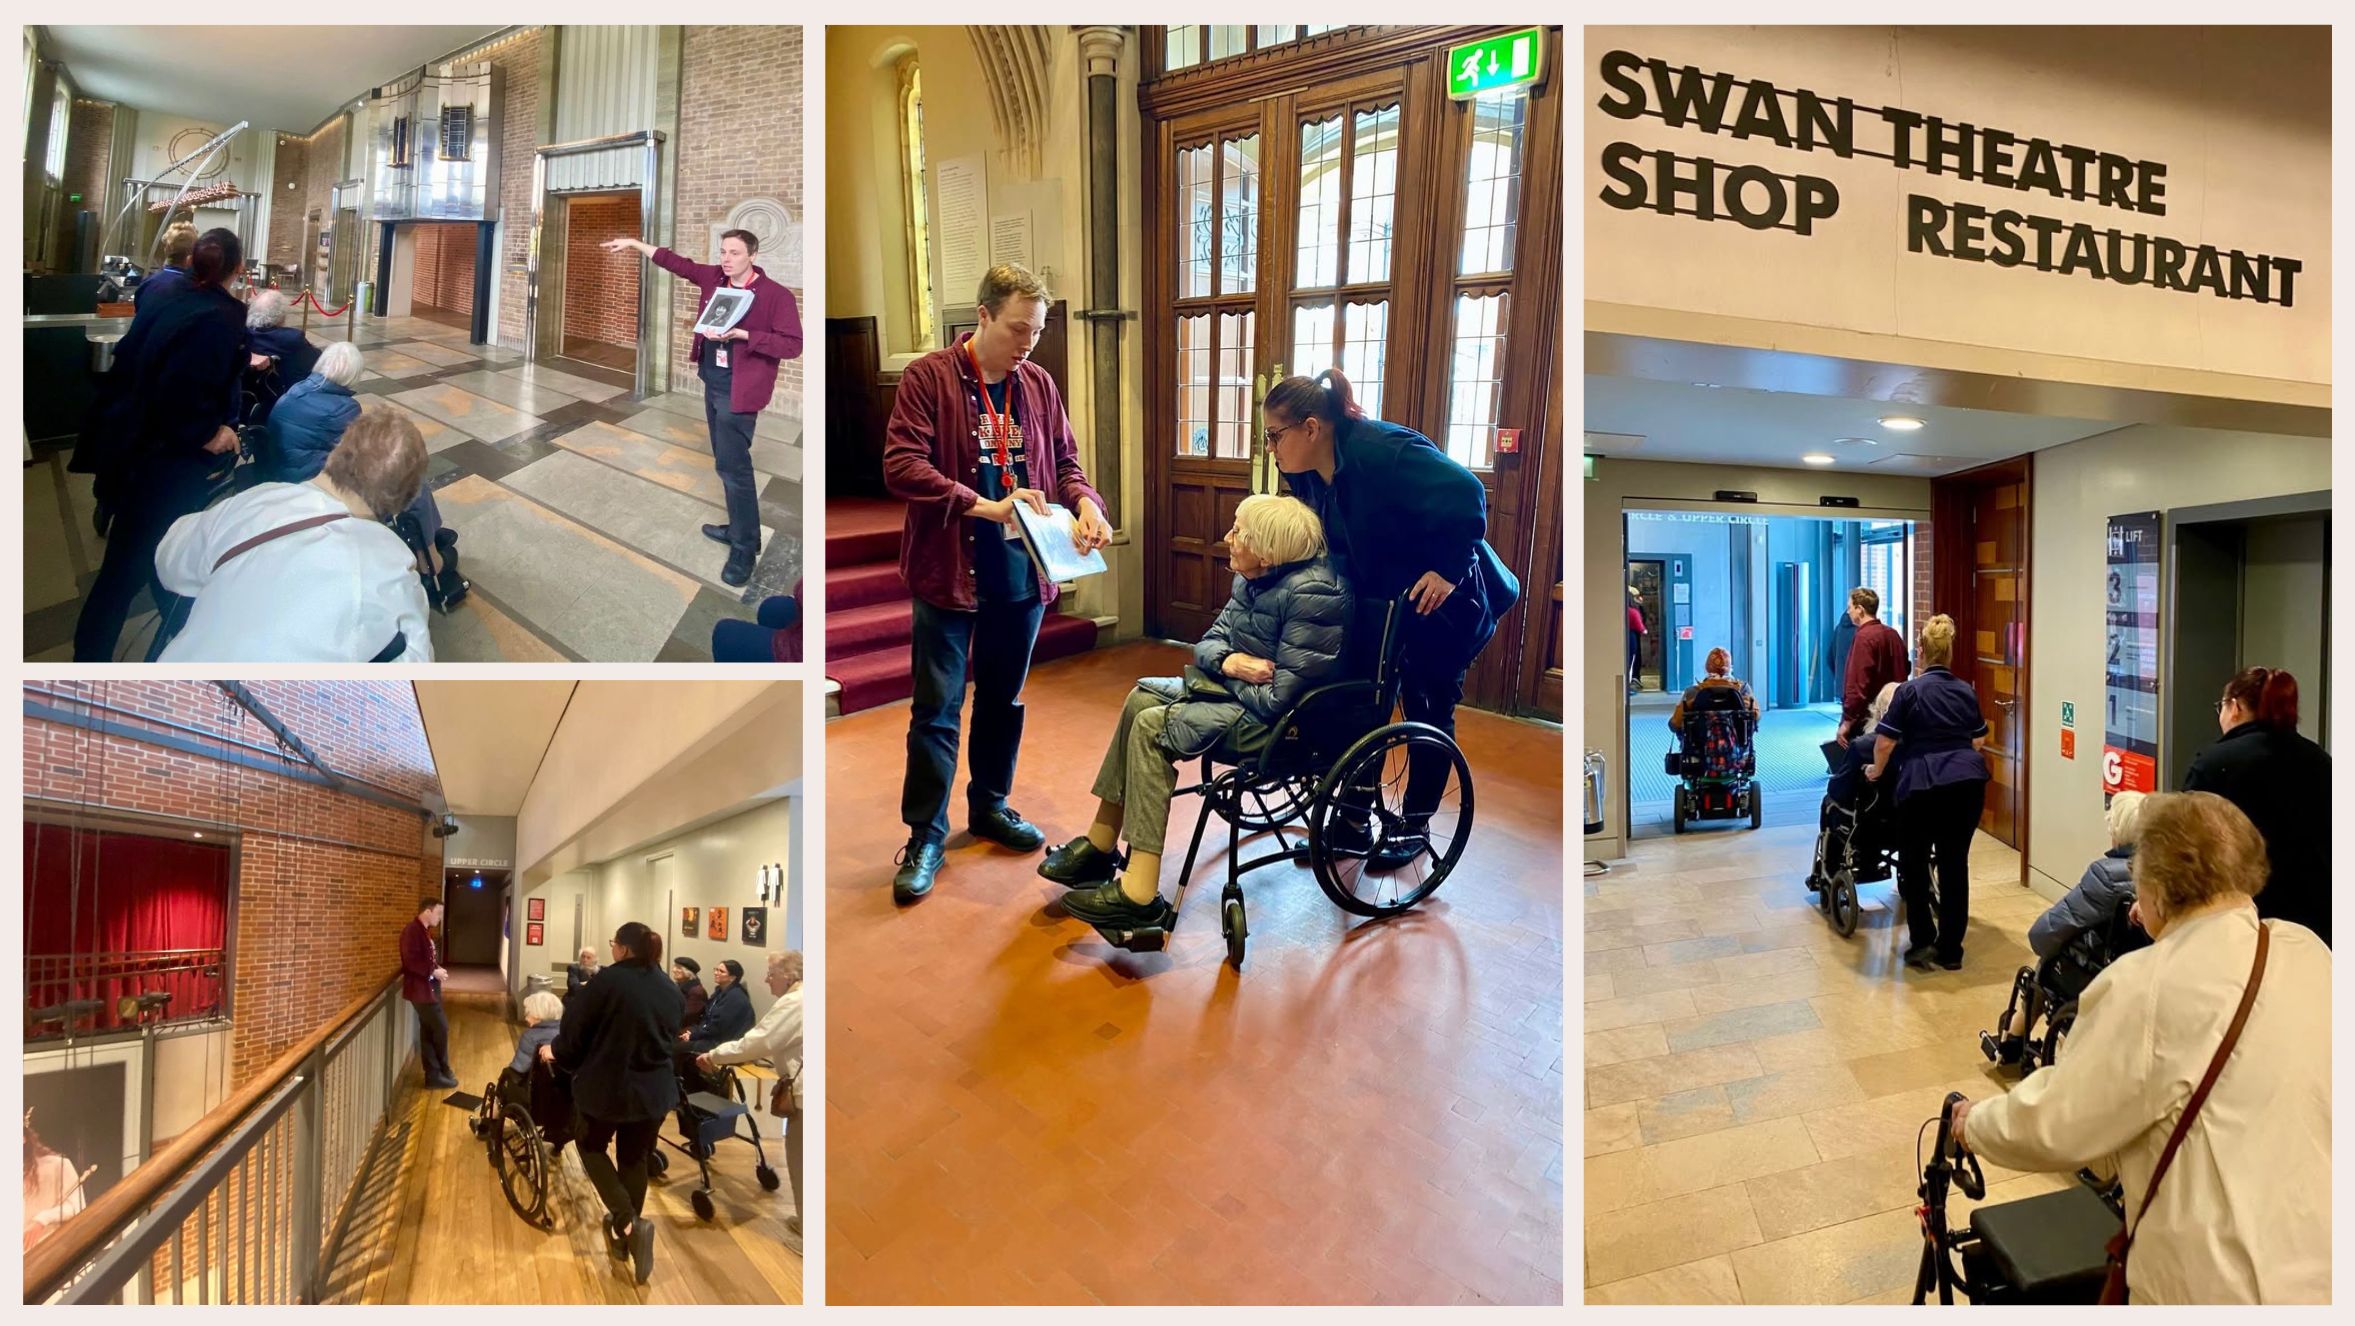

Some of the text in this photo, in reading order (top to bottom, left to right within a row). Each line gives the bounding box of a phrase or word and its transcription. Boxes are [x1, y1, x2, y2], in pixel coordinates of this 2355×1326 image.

[1598, 50, 2168, 216] SWAN THEATRE
[1599, 141, 1840, 236] SHOP
[1907, 193, 2302, 308] RESTAURANT
[2125, 529, 2143, 542] LIFT
[2108, 572, 2121, 604] 3
[2107, 634, 2121, 665] 2
[2108, 694, 2117, 726] 1
[2103, 751, 2123, 785] G
[450, 857, 509, 867] UPPER CIRCLE
